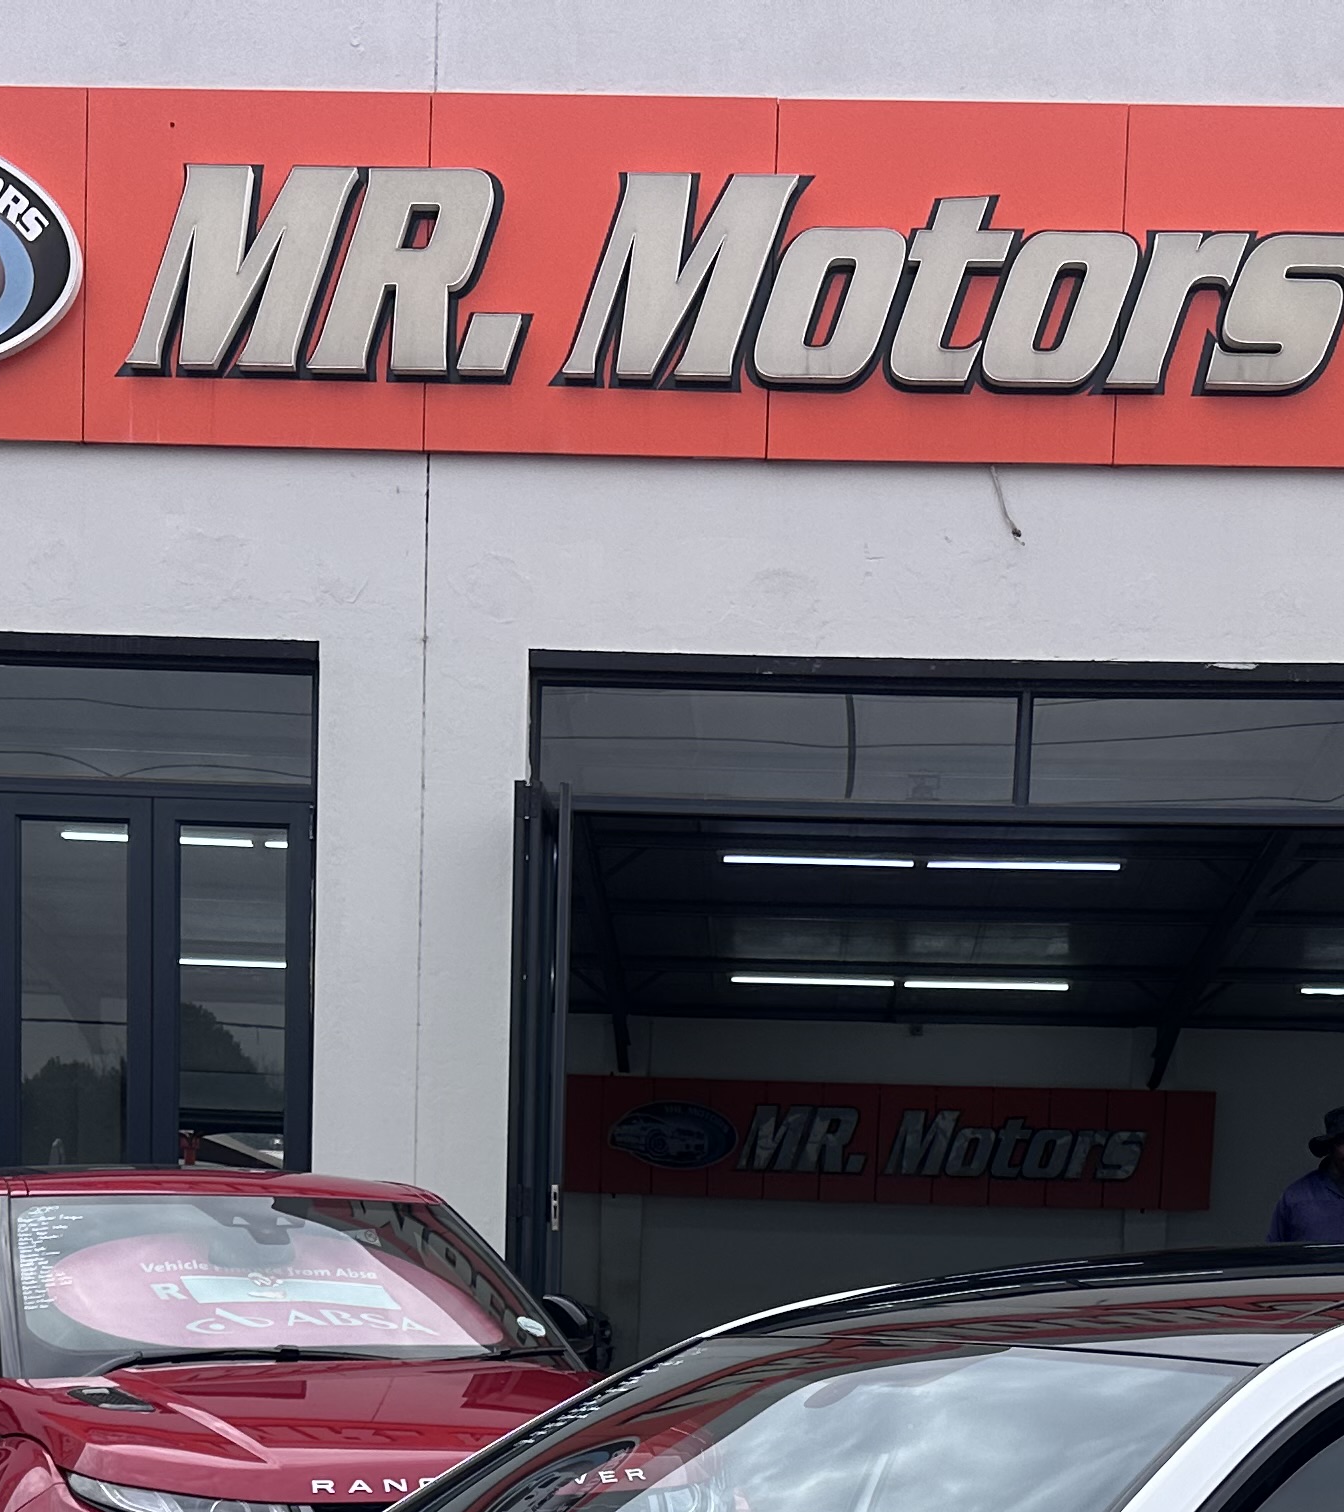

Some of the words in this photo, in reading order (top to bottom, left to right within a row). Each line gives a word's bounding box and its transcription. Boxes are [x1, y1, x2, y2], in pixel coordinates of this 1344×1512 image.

[118, 163, 532, 384] MR.
[734, 1104, 869, 1176] MR.
[883, 1108, 1148, 1182] Motors
[140, 1259, 208, 1274] Vehicle
[287, 1266, 331, 1278] from
[336, 1267, 378, 1280] Absa
[150, 1283, 189, 1301] R
[287, 1308, 440, 1337] ABSA
